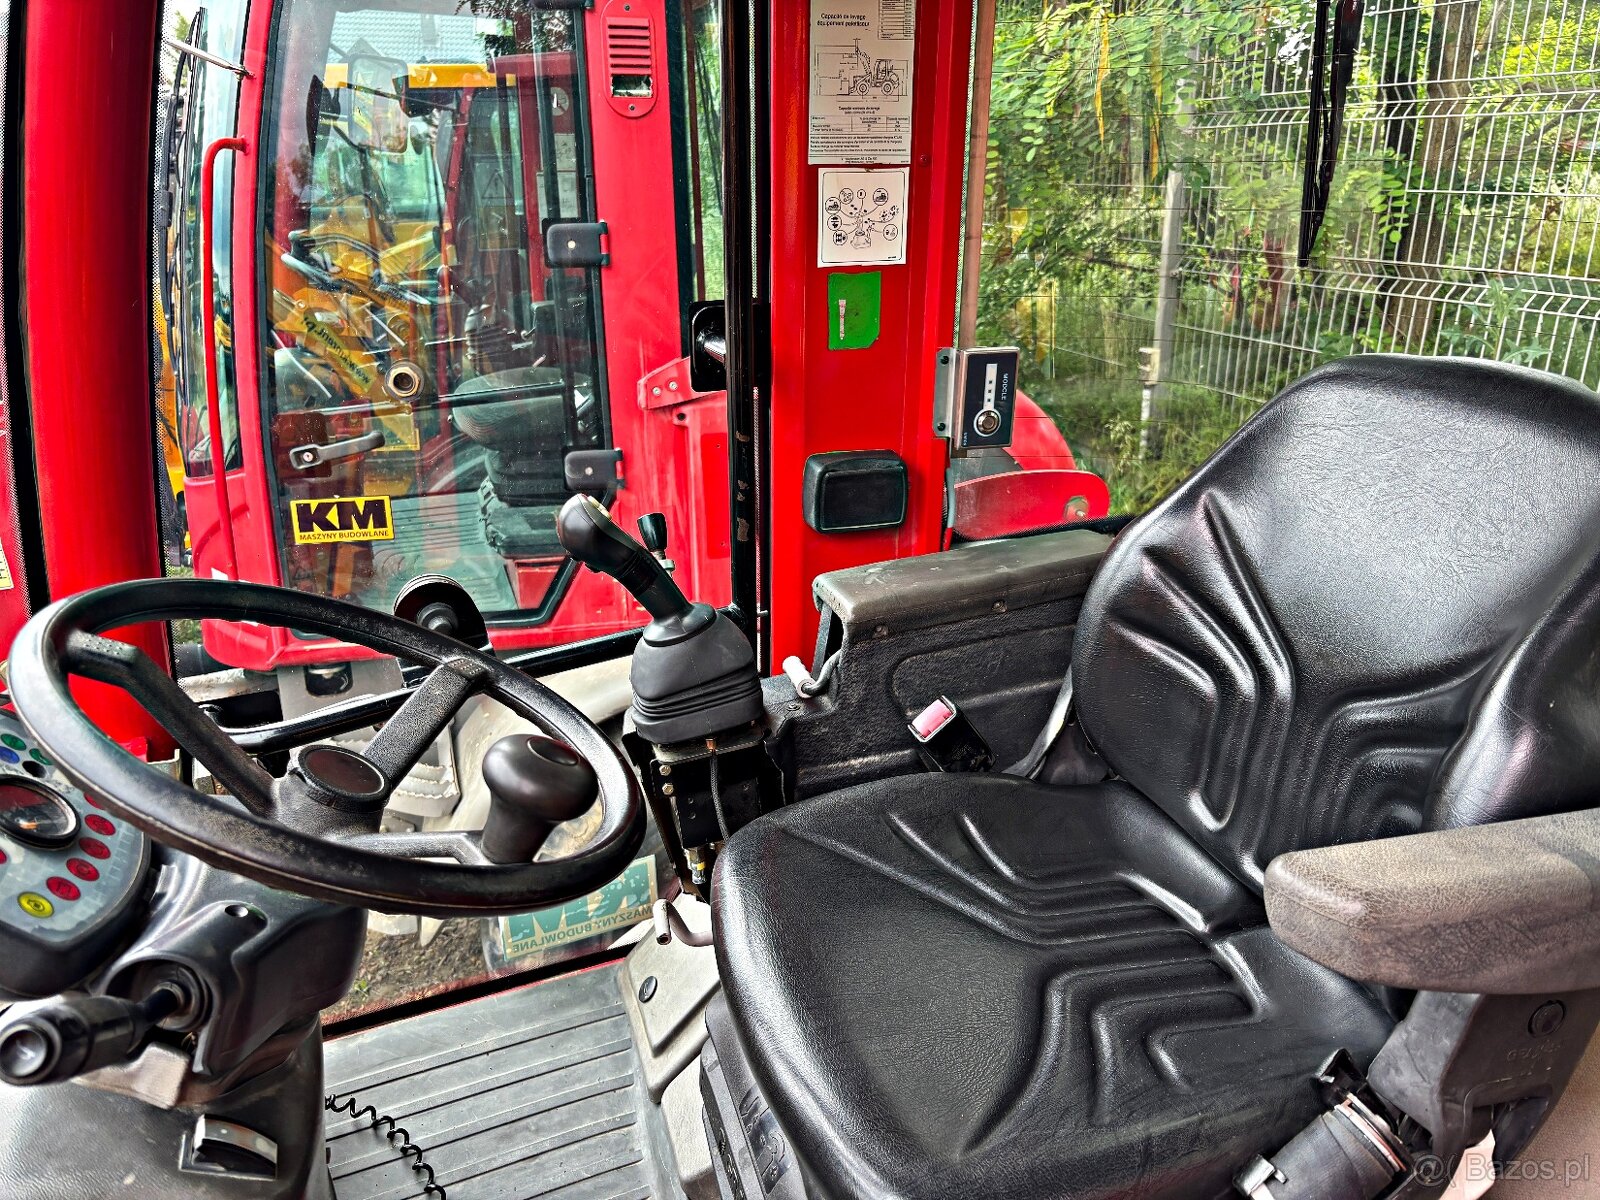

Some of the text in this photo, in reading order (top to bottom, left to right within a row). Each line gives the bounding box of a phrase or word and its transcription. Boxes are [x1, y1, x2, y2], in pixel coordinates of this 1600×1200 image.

[296, 500, 388, 532] KM
[299, 530, 389, 541] MASZYNY BUDOWLANE
